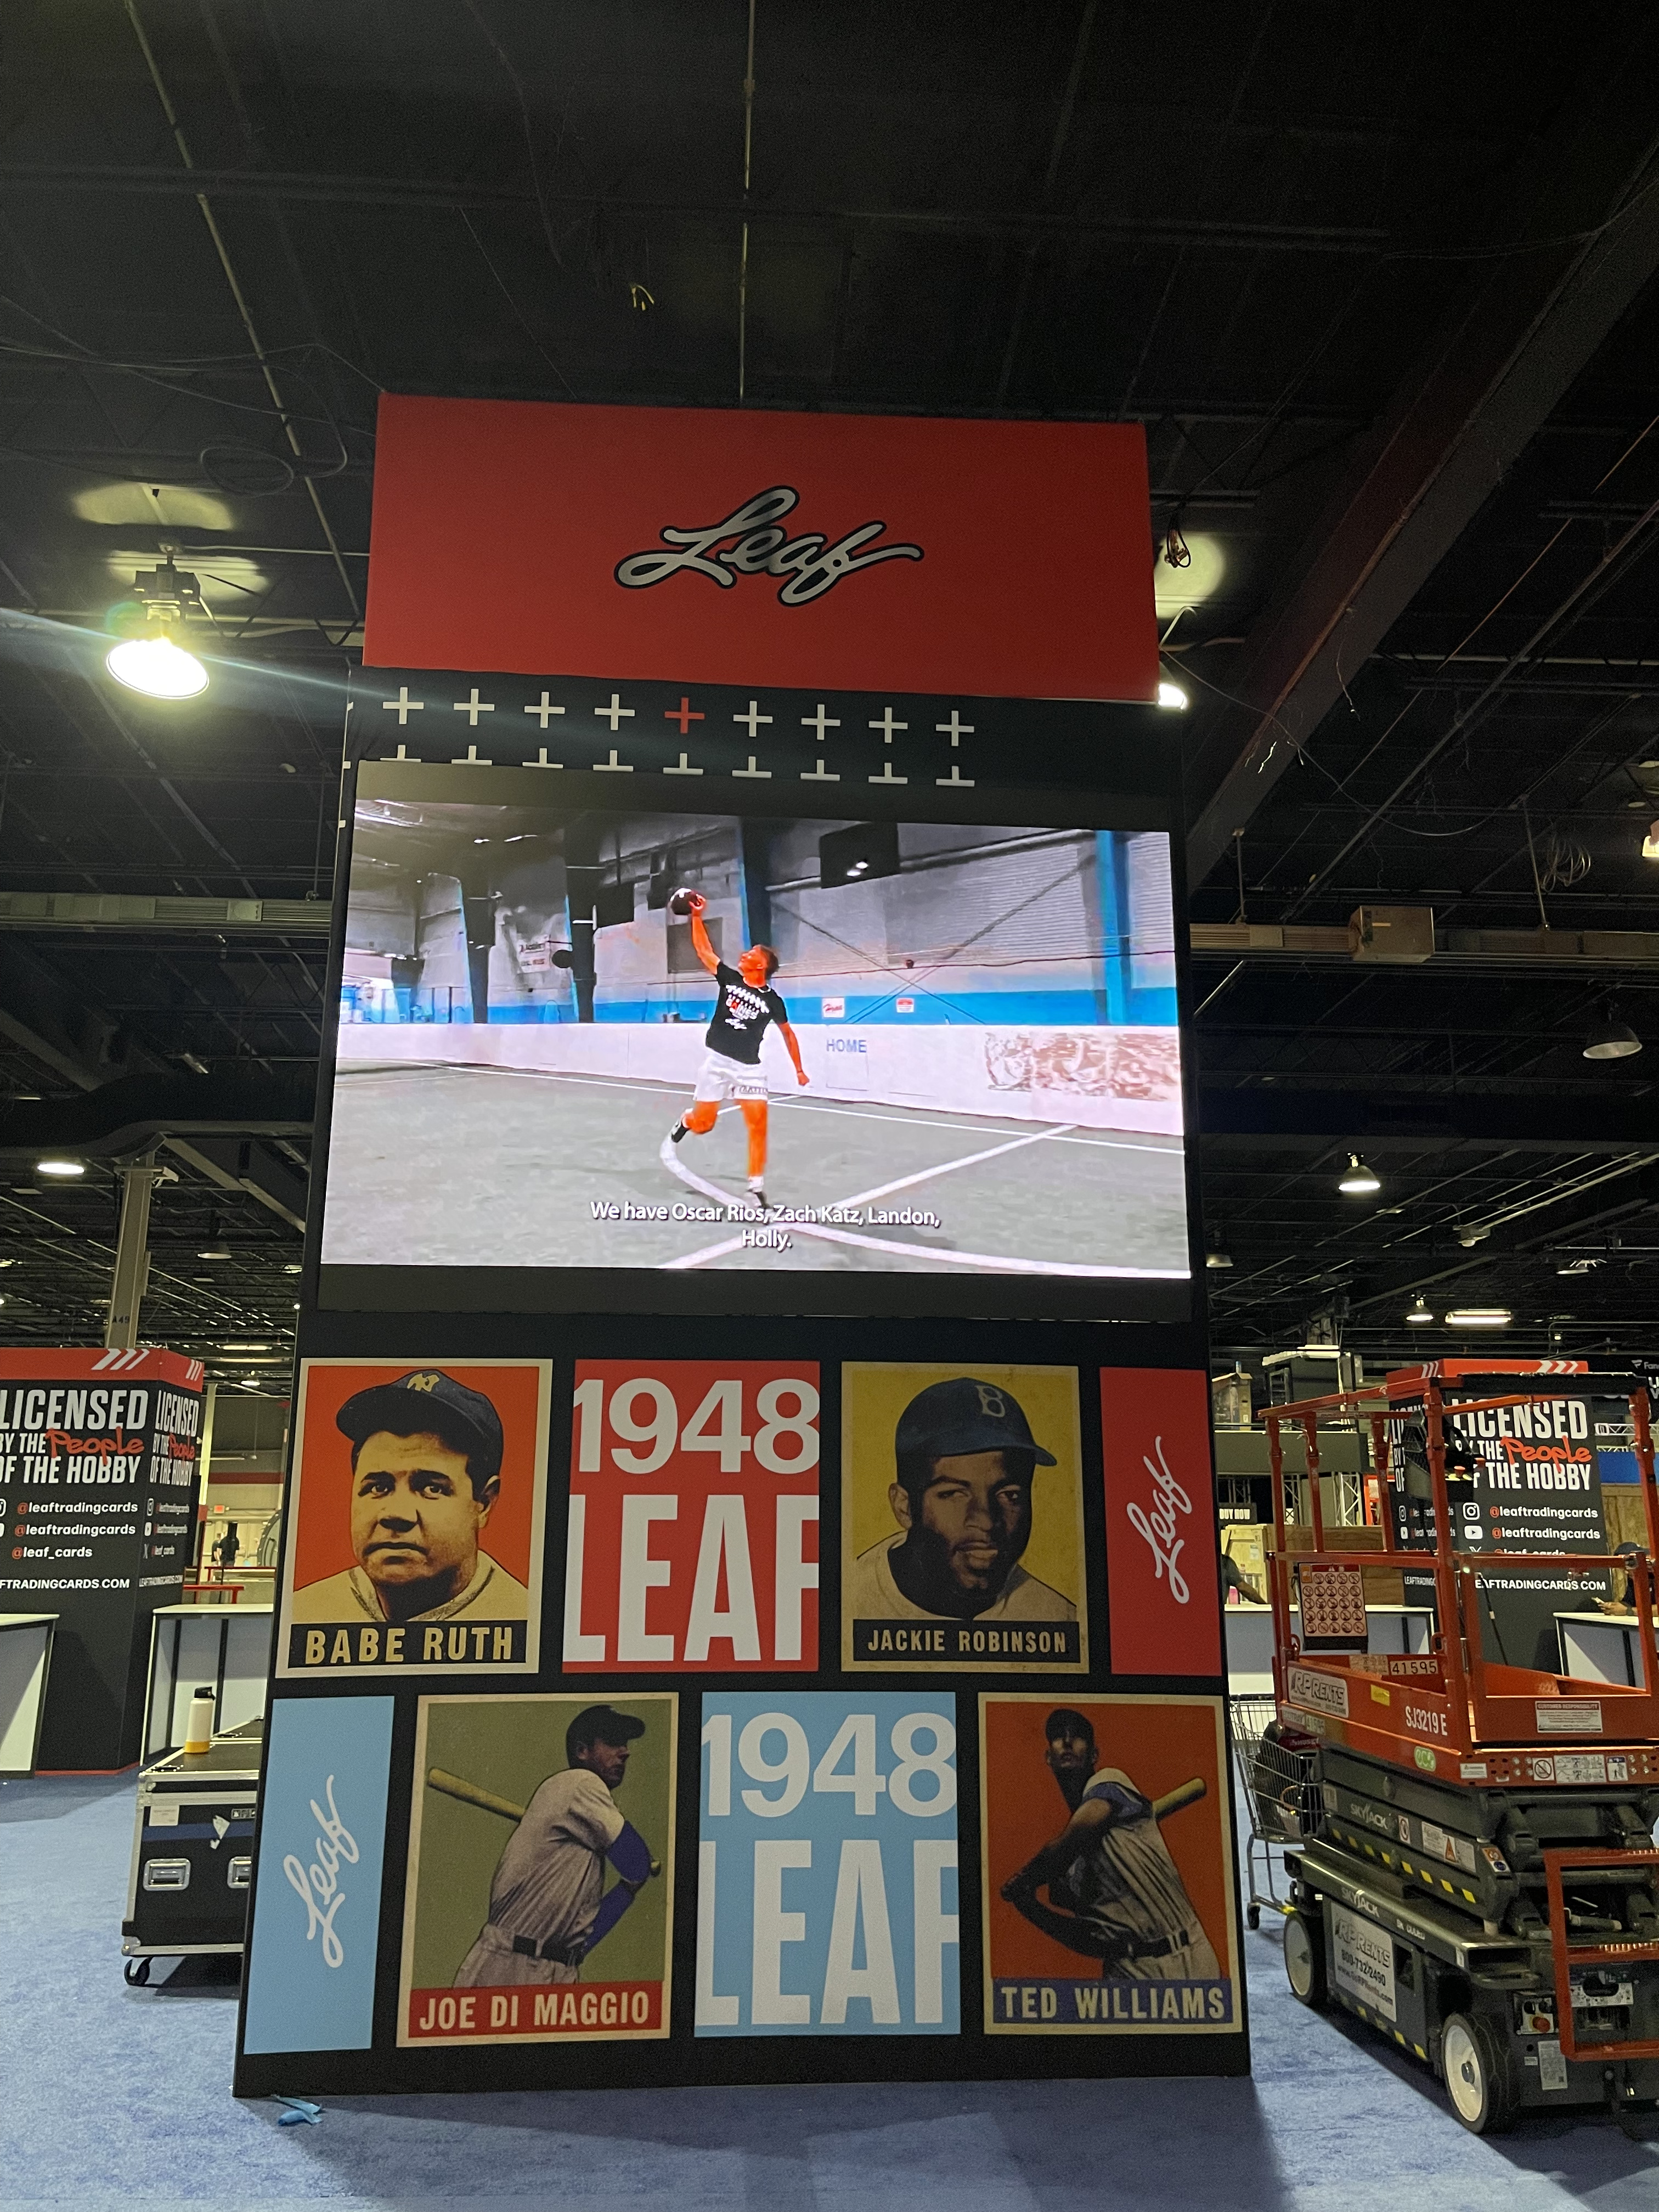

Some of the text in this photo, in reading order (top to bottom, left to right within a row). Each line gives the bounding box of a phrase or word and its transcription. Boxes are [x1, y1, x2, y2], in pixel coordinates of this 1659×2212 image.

[614, 486, 924, 607] Leaf
[826, 1039, 867, 1053] HOME
[590, 1201, 940, 1228] We have Oscar Rios, Zach Katz, Landon,
[742, 1229, 792, 1252] Holly.
[0, 1390, 149, 1430] LICENSED
[155, 1390, 200, 1437] LICENSED
[573, 1378, 820, 1474] 1948
[19, 1433, 46, 1453] THE
[45, 1426, 145, 1466] People
[1477, 1440, 1504, 1461] THE
[1500, 1435, 1592, 1472] People
[23, 1455, 61, 1483] THE
[66, 1455, 141, 1484] HOBBY
[1486, 1463, 1522, 1489] THE
[1526, 1463, 1591, 1491] HOBBY
[17, 1502, 138, 1515] @leaftradingcards
[1126, 1436, 1192, 1604] Leaf
[1489, 1506, 1599, 1519] @leaftradingcards
[15, 1524, 136, 1537] @leaftradingcards
[1492, 1527, 1601, 1541] @leaftradingcards
[12, 1547, 93, 1560] @leaf_cards
[562, 1494, 820, 1662] LEAF
[305, 1627, 512, 1664] BABE RUTH
[868, 1629, 1066, 1653] JACKIE ROBINSON
[1392, 1661, 1437, 1674] 41595
[701, 1712, 957, 1817] 1948
[283, 1774, 359, 1968] Leaf
[695, 1839, 959, 2026] LEAF
[419, 1990, 650, 2030] JOE DI MAGGIO
[1001, 1986, 1225, 2019] TED WILLIAMS
